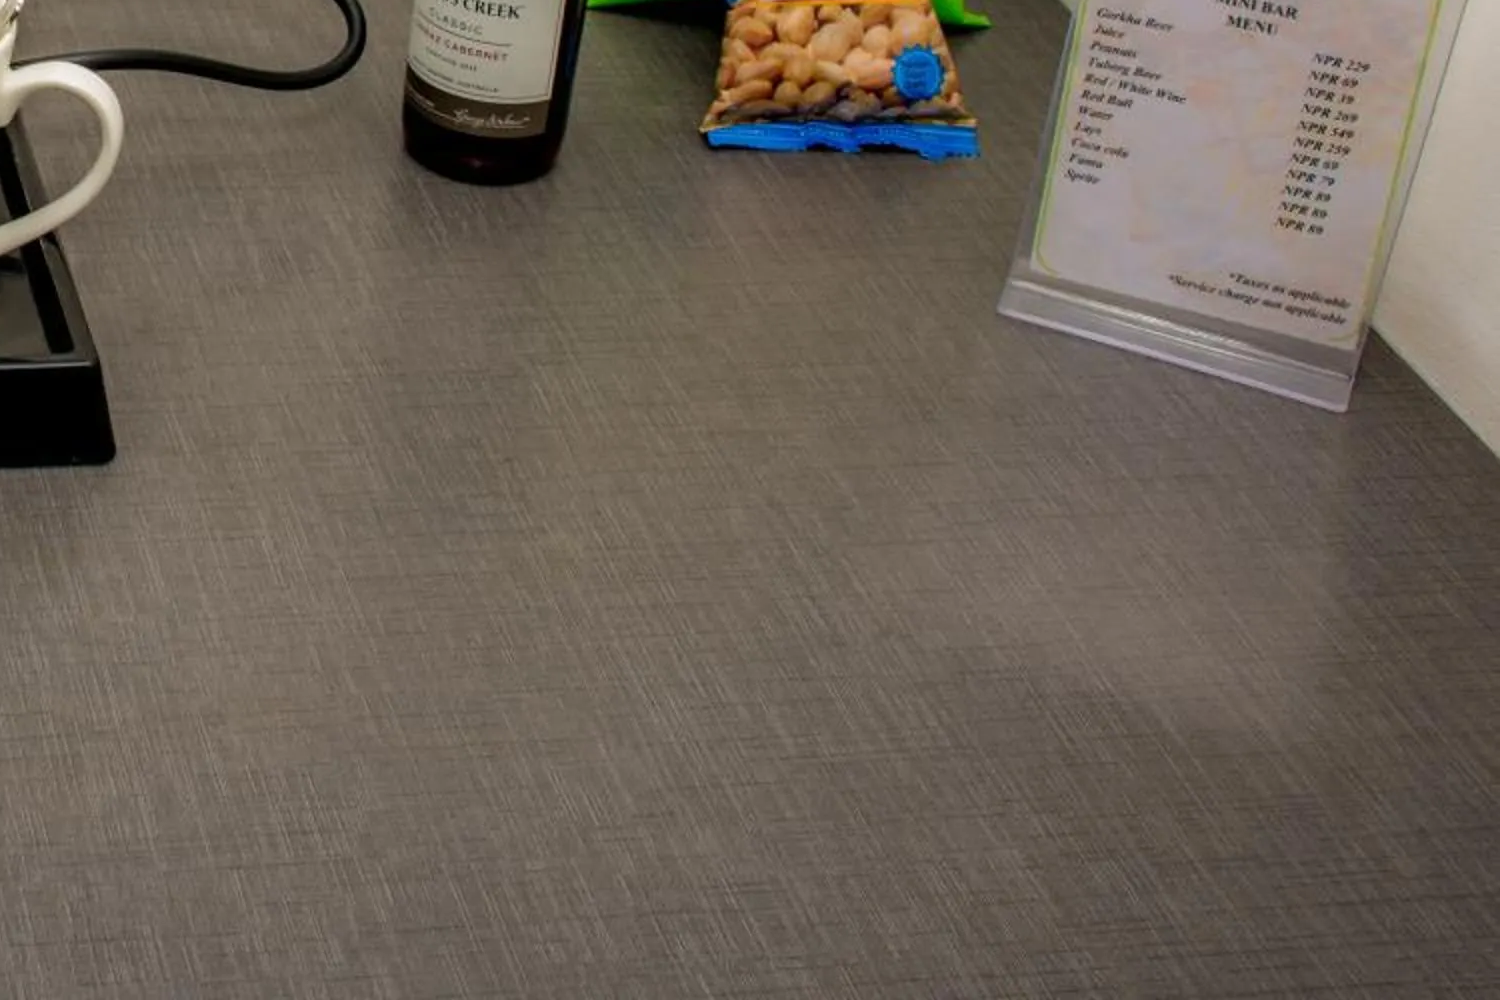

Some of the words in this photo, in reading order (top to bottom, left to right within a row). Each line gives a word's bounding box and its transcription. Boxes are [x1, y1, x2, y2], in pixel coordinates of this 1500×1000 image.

[1261, 1, 1299, 20] BAR
[1097, 7, 1143, 25] Gorkha
[1145, 17, 1174, 32] Beer
[1226, 15, 1278, 36] MENU
[1090, 41, 1137, 58] Peanuts
[1313, 53, 1343, 68] NPR
[1309, 70, 1339, 85] NPR
[1081, 89, 1105, 103] Red
[1084, 73, 1108, 87] Red
[1117, 79, 1153, 96] White
[1156, 88, 1187, 104] Wine
[1304, 87, 1335, 101] NPR
[1301, 103, 1331, 119] NPR
[1297, 120, 1328, 136] NPR
[1293, 136, 1323, 152] NPR
[1289, 153, 1320, 168] NPR
[1286, 169, 1316, 183] NPR
[1282, 185, 1312, 200] NPR
[1278, 201, 1309, 216] NPR
[1275, 217, 1305, 232] NPR
